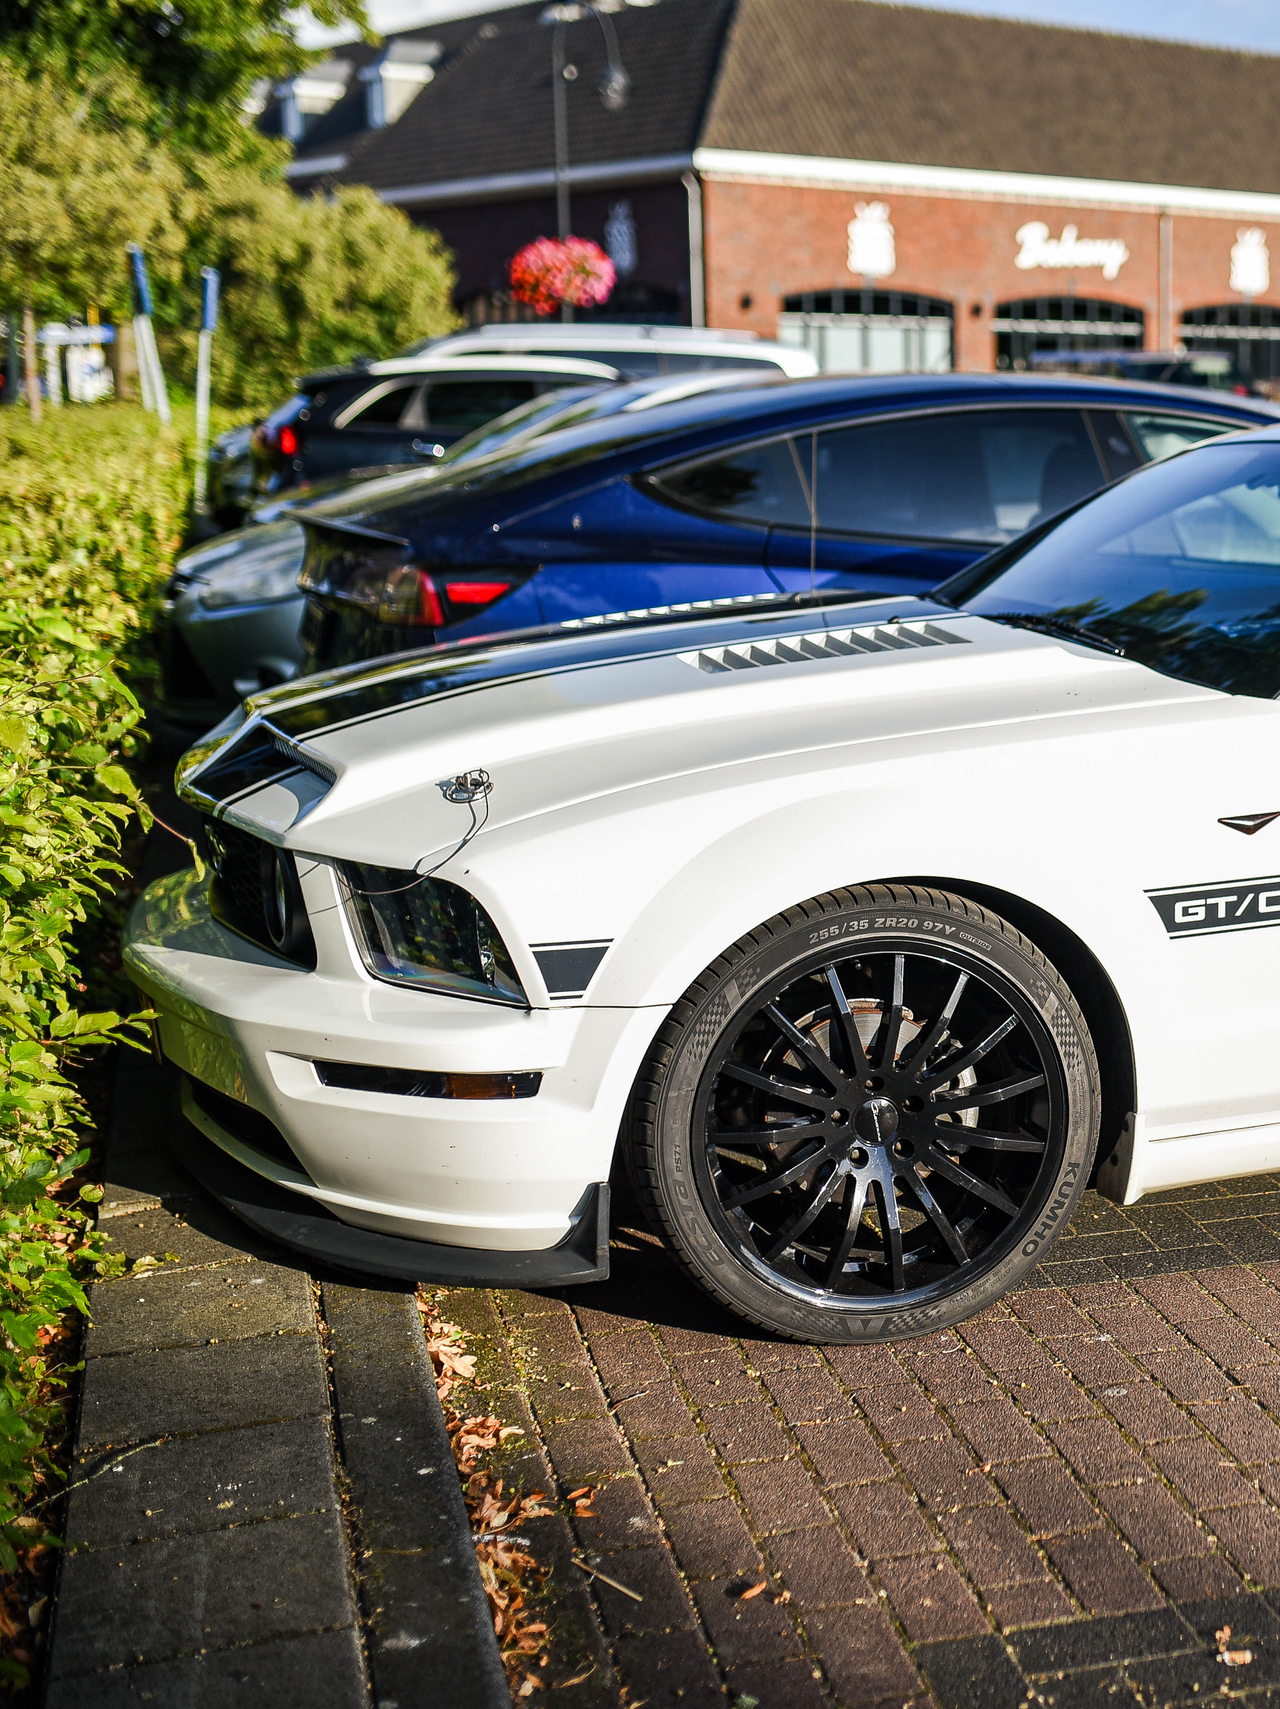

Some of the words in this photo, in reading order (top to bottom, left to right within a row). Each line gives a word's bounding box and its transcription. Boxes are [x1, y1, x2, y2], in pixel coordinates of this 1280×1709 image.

[808, 918, 869, 944] 255/35
[874, 917, 919, 928] ZR20
[922, 919, 957, 936] 97Y
[673, 1144, 683, 1173] PS71
[1022, 1161, 1081, 1257] KUMHO
